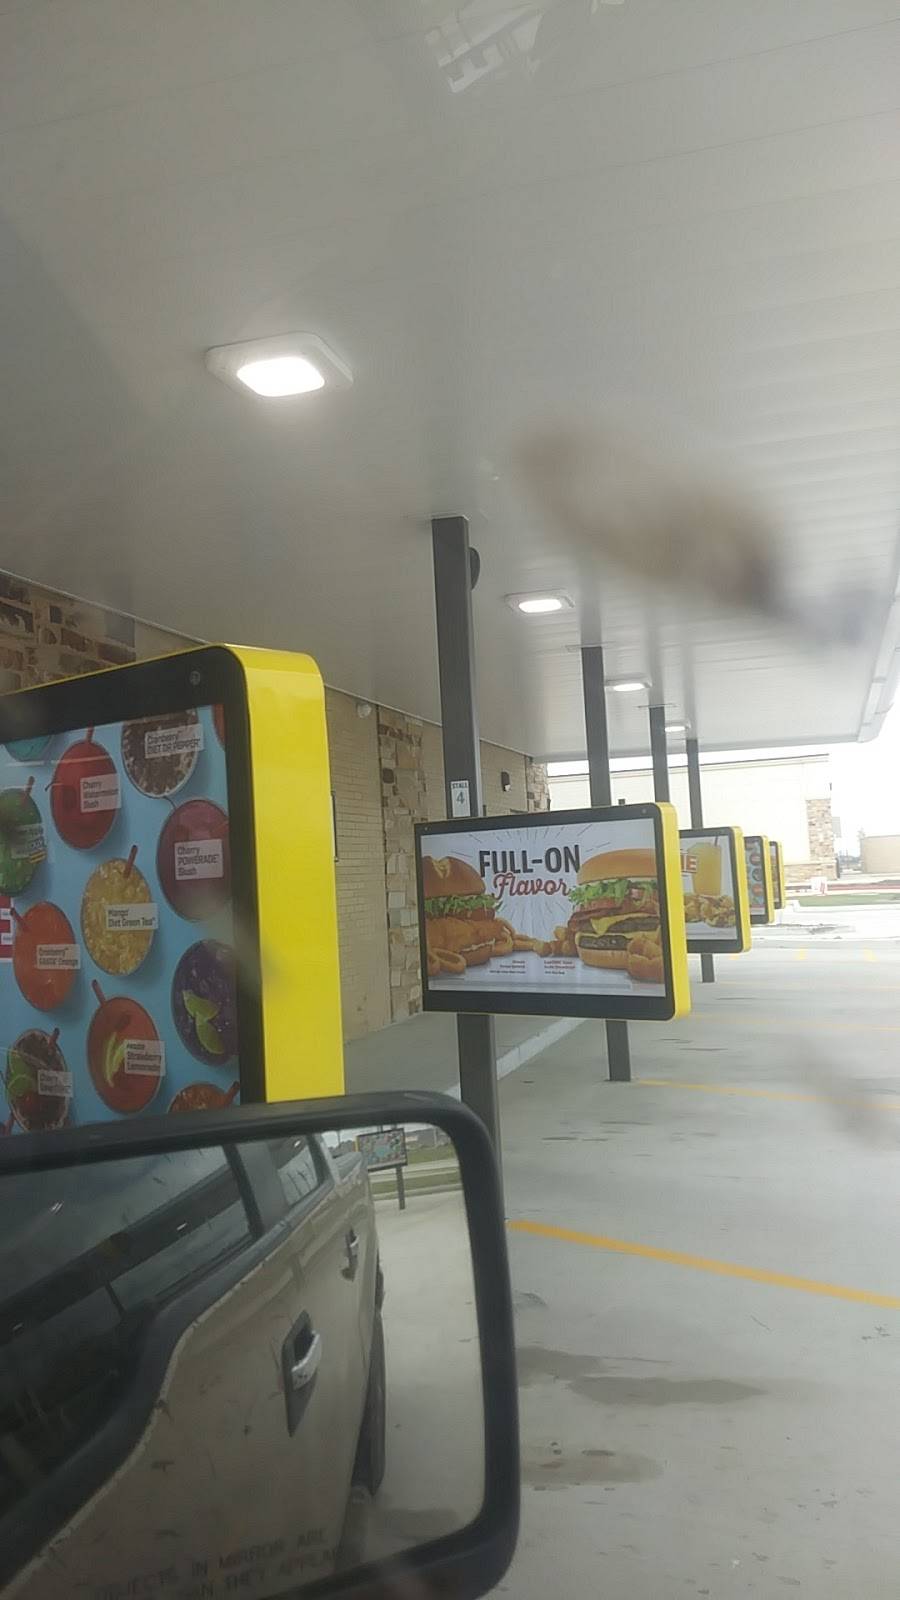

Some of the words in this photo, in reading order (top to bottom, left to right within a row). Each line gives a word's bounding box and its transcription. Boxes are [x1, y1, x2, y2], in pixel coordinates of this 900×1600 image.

[456, 791, 466, 805] 4
[177, 846, 200, 857] Cherry
[479, 844, 580, 878] FULL-ON
[177, 867, 197, 877] Slush
[491, 872, 571, 901] Flavor
[108, 918, 121, 928] Diet
[121, 917, 140, 927] Green
[192, 1559, 209, 1577] IN
[219, 1538, 285, 1570] MIRROR
